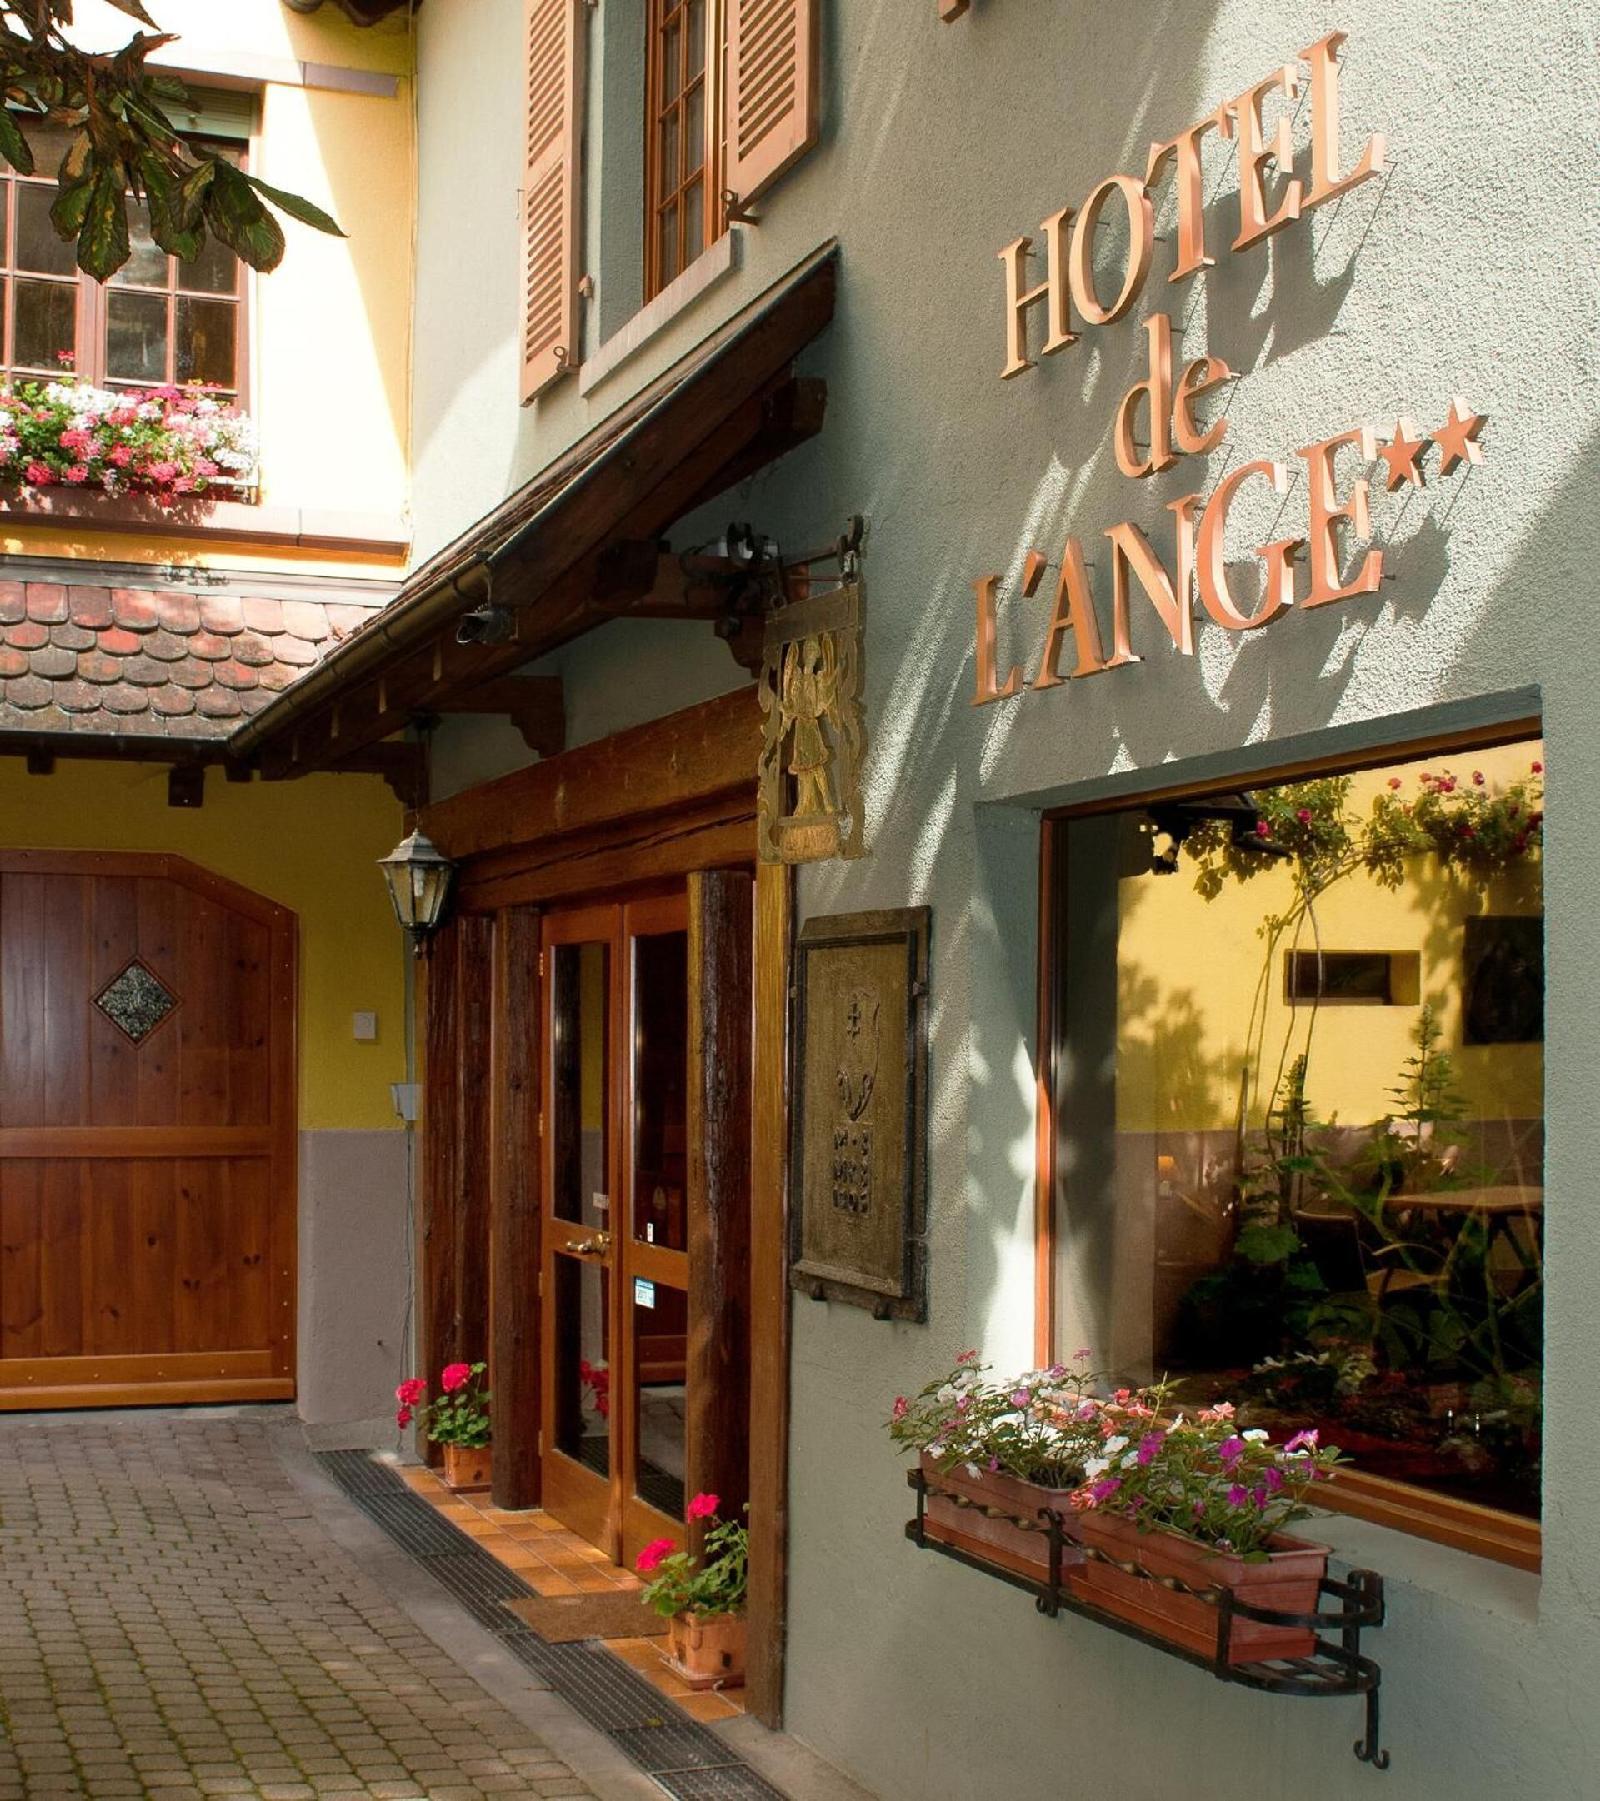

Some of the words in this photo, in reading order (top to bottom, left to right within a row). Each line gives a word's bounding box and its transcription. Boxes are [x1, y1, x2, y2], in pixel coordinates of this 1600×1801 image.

[998, 31, 1386, 379] HOTEL
[1115, 313, 1236, 478] de
[971, 427, 1384, 707] L'ANGE
